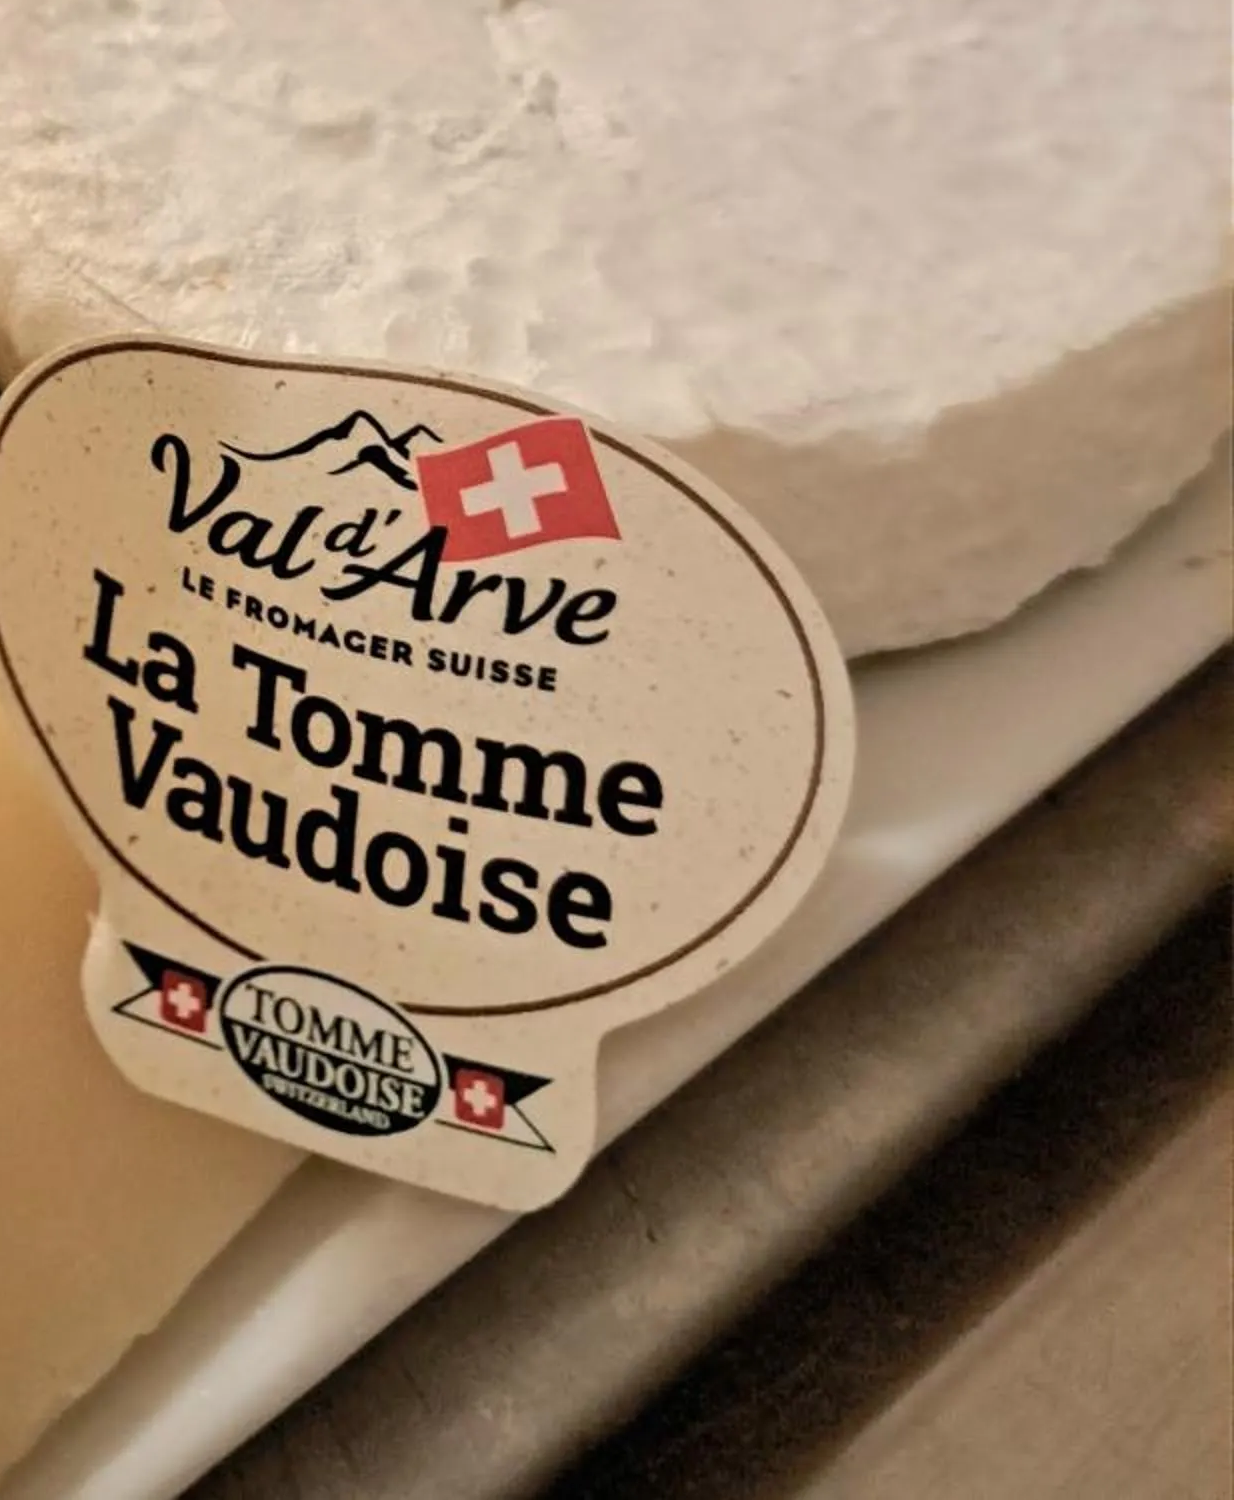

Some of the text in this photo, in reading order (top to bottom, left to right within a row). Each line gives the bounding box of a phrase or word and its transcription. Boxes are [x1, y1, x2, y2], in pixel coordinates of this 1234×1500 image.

[151, 433, 618, 645] Val d'Arve
[82, 567, 663, 836] La Tomme
[181, 566, 558, 692] LE FROMAGER SUISSE
[106, 696, 614, 950] Vaudoise
[230, 1025, 425, 1118] VAUDOISE
[246, 984, 414, 1073] TOMME
